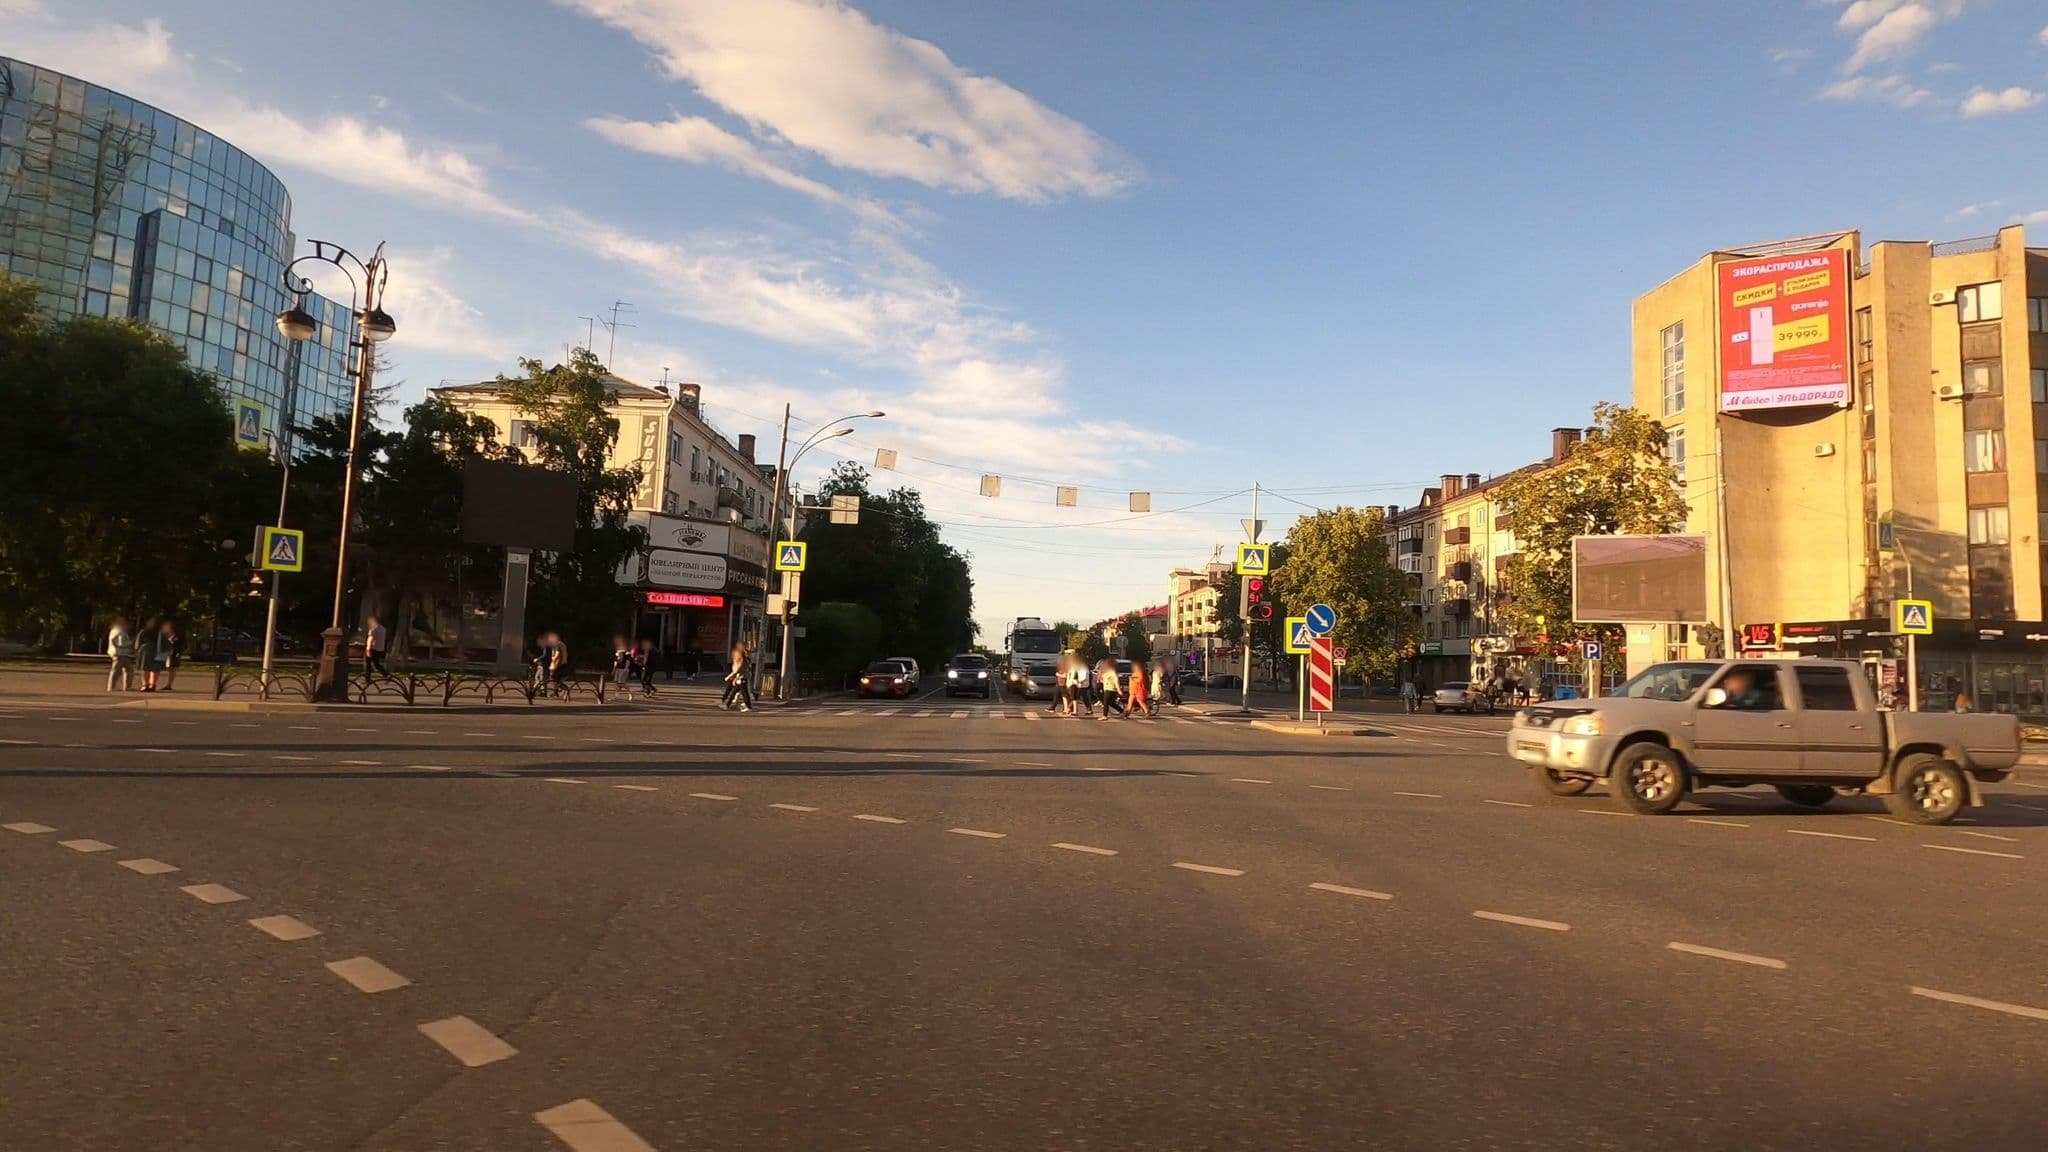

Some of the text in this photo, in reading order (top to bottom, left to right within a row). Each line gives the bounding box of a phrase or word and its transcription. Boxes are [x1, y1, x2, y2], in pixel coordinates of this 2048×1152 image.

[1732, 257, 1830, 277] ЭКОРАСПРОДАЖА
[1736, 287, 1773, 302] СКИДКИ
[1776, 390, 1844, 403] ЭЛЬДОРАДО
[638, 421, 657, 500] SUBWAY
